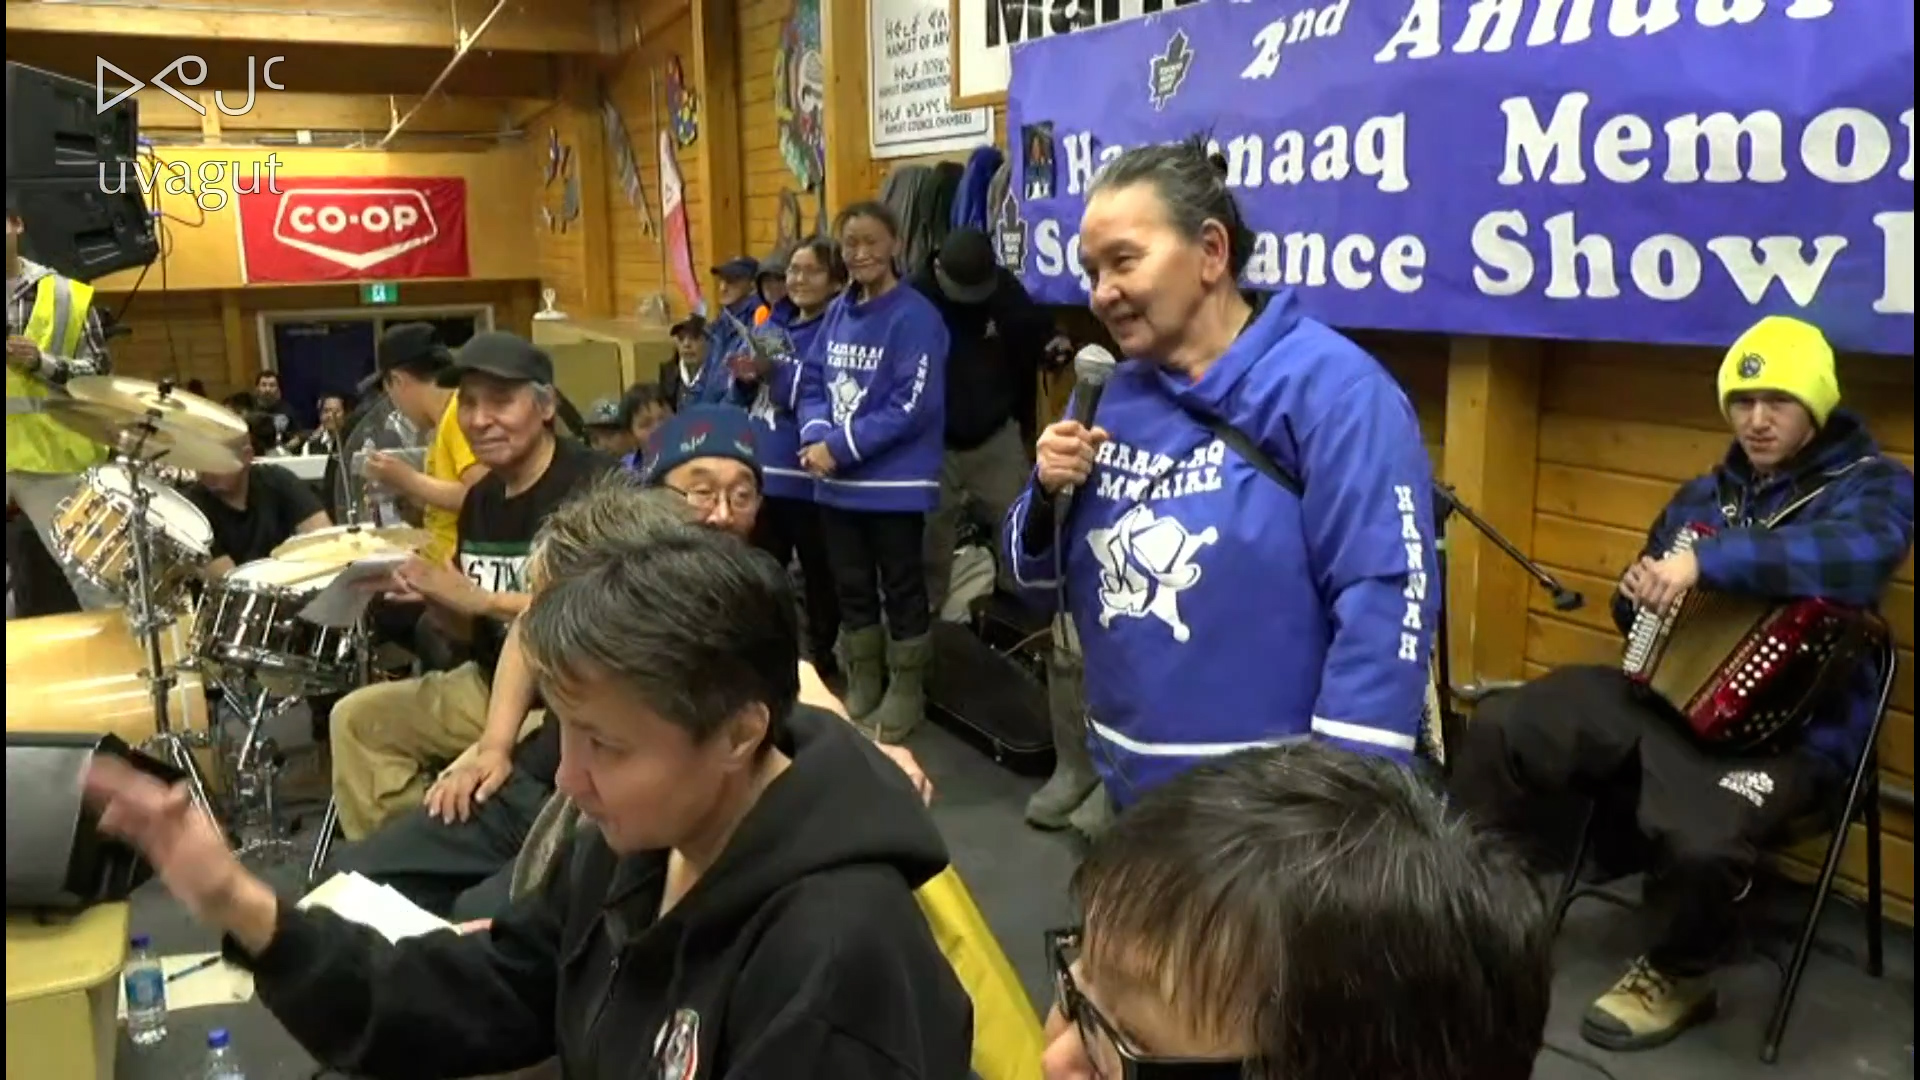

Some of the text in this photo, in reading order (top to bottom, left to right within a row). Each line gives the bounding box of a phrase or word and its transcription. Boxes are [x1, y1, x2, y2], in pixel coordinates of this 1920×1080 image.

[1240, 0, 1350, 79] 2nd
[289, 204, 419, 234] CO-OP
[1471, 209, 1849, 308] Show
[1394, 484, 1428, 662] HANNAH
